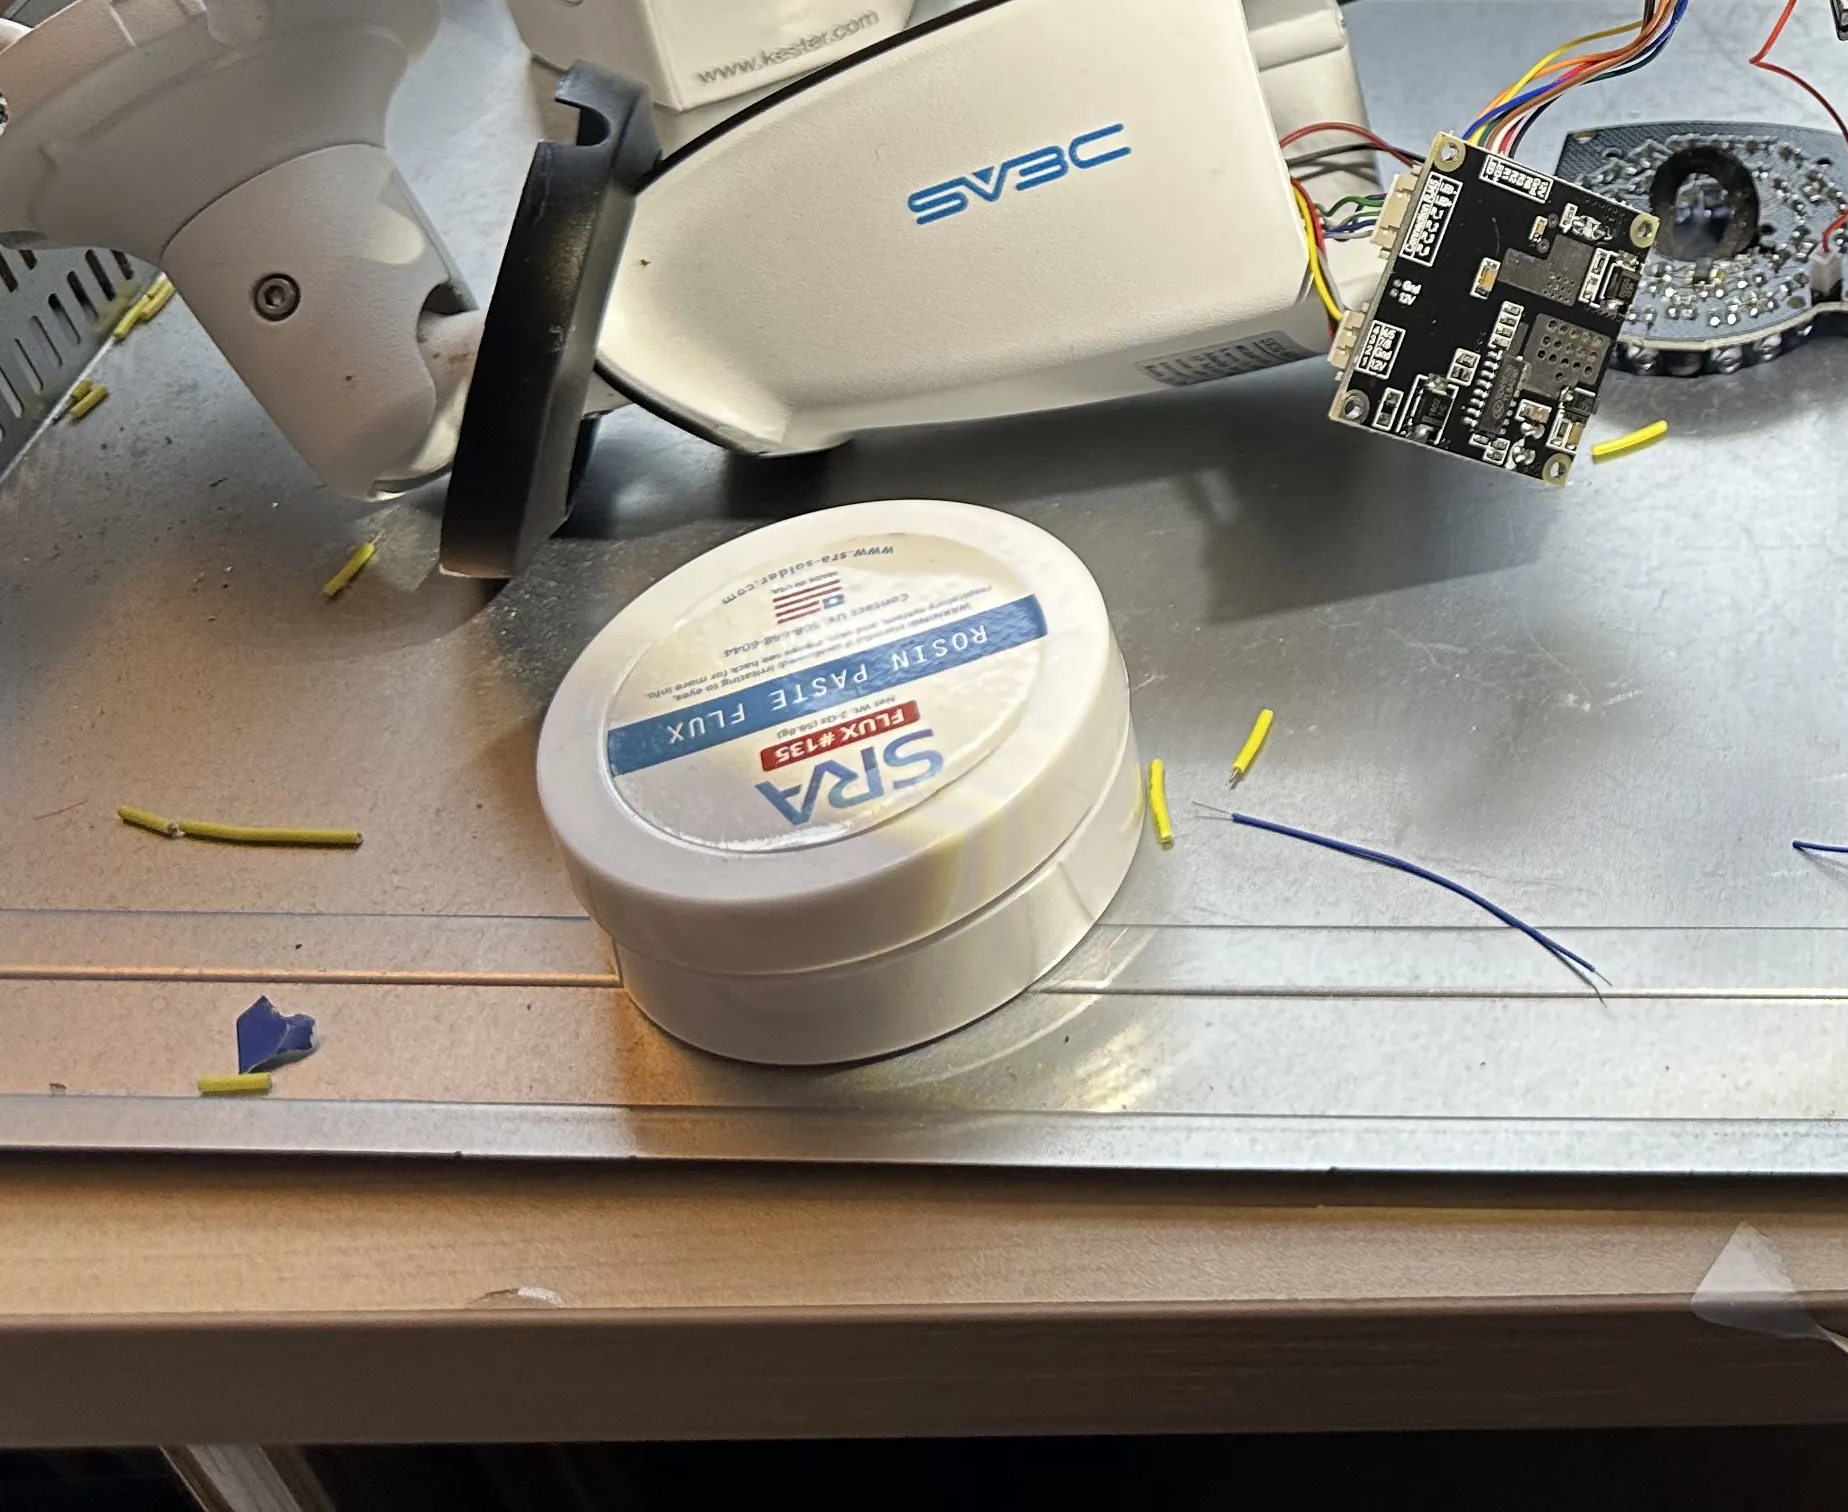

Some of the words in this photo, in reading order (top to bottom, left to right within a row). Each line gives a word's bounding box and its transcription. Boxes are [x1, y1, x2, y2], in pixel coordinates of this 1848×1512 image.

[697, 9, 880, 85] www.kester.com
[891, 624, 988, 672] ROSIN
[768, 663, 869, 712] PASTE
[665, 703, 746, 744] FLUX
[774, 731, 836, 763] #135
[840, 708, 906, 741] FLUX
[754, 728, 945, 826] SRA
